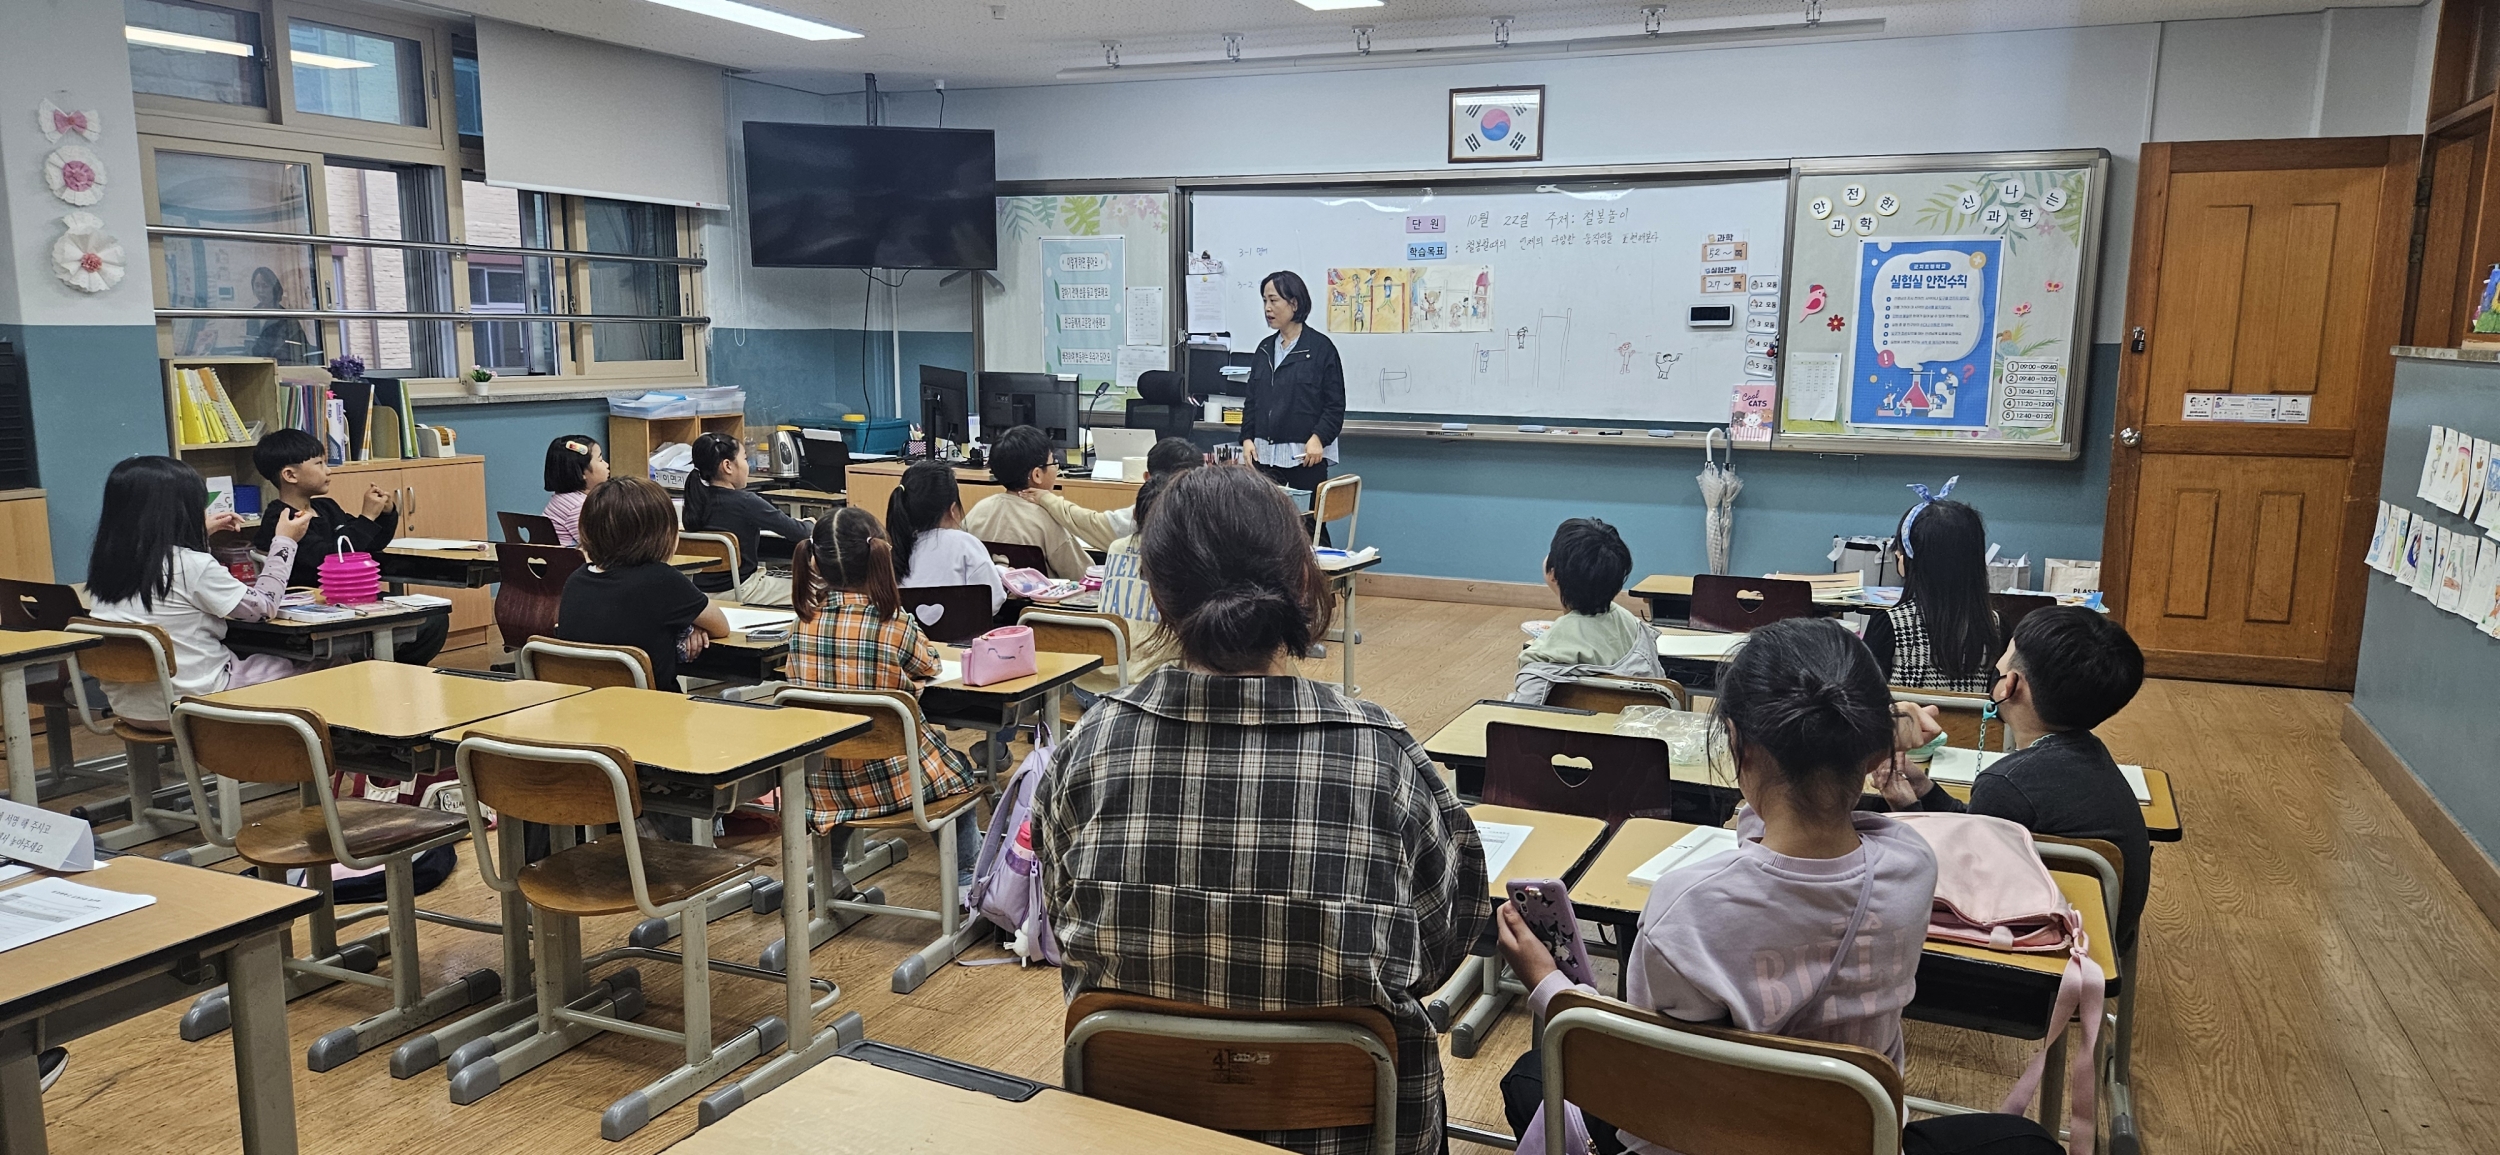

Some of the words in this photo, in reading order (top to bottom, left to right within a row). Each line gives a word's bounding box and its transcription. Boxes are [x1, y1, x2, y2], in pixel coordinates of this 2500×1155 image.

[1986, 206, 2035, 224] 과학
[1831, 214, 1875, 232] 과학
[1716, 233, 1734, 243] 과학
[1409, 246, 1445, 258] 학습목표
[1890, 274, 1924, 290] 실험실
[1925, 274, 1968, 290] 안전수칙
[1748, 400, 1768, 408] CATS
[662, 473, 686, 486] 이면지
